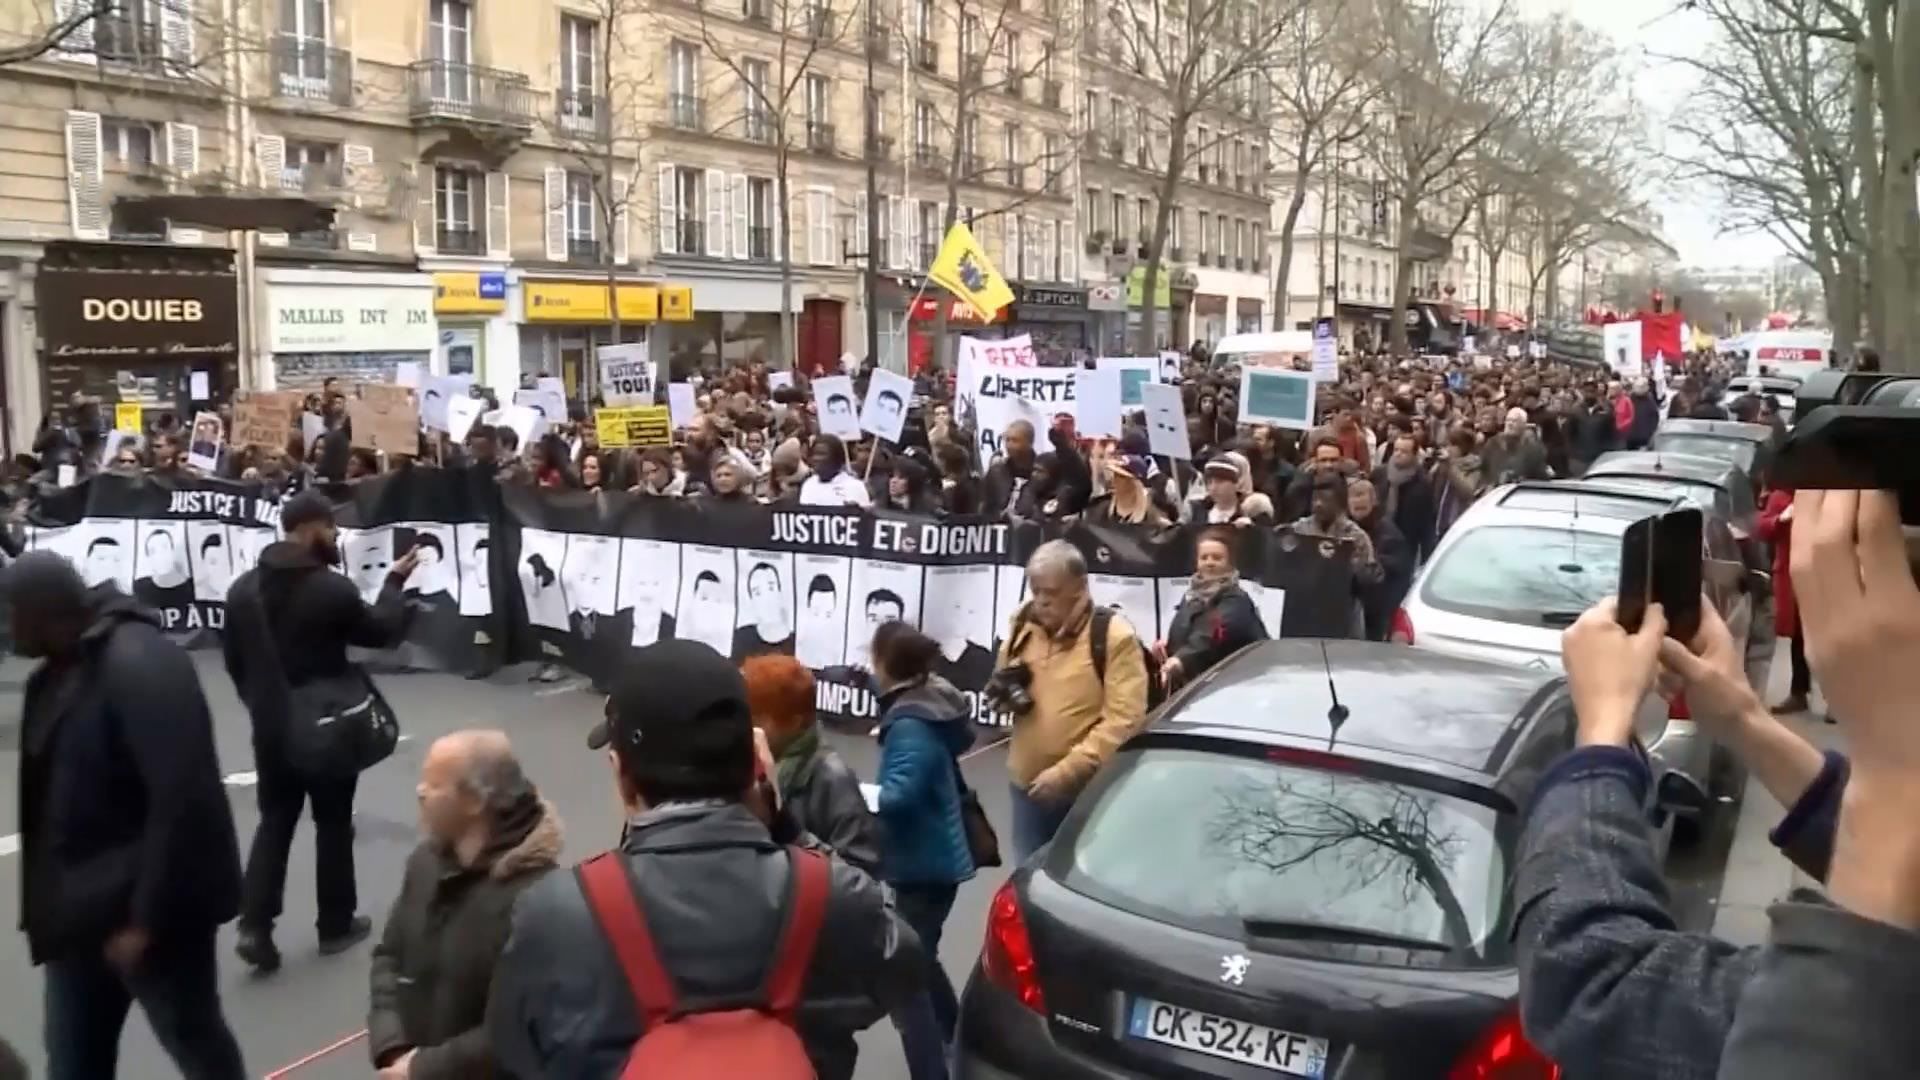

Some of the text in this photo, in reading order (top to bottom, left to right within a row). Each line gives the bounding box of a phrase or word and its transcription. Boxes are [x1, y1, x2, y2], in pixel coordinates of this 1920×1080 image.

[82, 298, 203, 322] DOUIEB
[1774, 349, 1805, 361] AVIS
[980, 373, 1076, 403] LIBERTÉ
[771, 512, 860, 547] JUSTICE
[873, 520, 907, 551] ET
